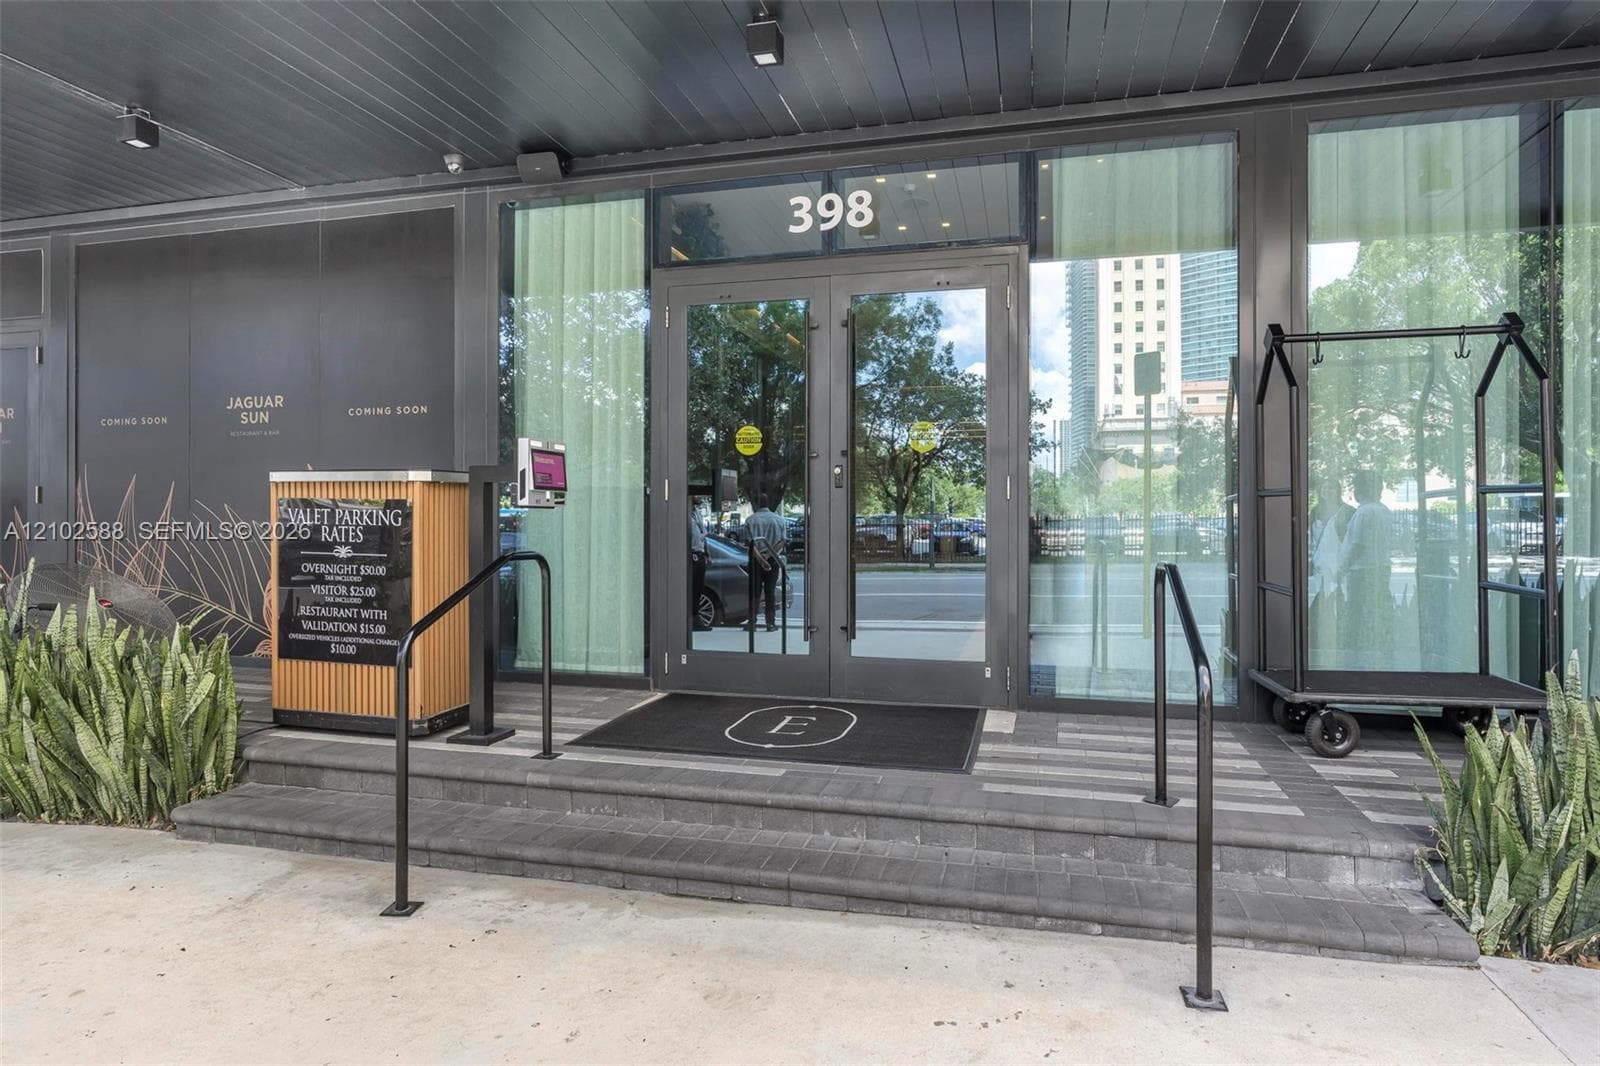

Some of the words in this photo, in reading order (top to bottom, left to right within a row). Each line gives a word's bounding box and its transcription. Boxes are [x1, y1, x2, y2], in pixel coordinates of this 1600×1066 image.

[788, 190, 874, 234] 398
[226, 395, 284, 410] JAGUAR
[348, 406, 391, 416] COMING
[396, 405, 428, 415] SOON
[100, 418, 137, 426] COMING
[141, 416, 168, 425] SOON
[240, 411, 269, 425] SUN
[288, 508, 331, 525] VALET
[335, 509, 402, 526] PARKING
[321, 526, 364, 542] RATES
[301, 562, 358, 575] OVERNIGHT
[360, 565, 387, 576] $50.00
[310, 584, 348, 596] VISITOR
[350, 586, 376, 597] $25.00
[300, 606, 358, 619] RESTAURANT
[360, 609, 388, 620] WITH
[301, 620, 358, 633] VALIDATION
[360, 624, 386, 634] $15.00
[330, 643, 357, 654] $10.00
[765, 715, 817, 735] E
